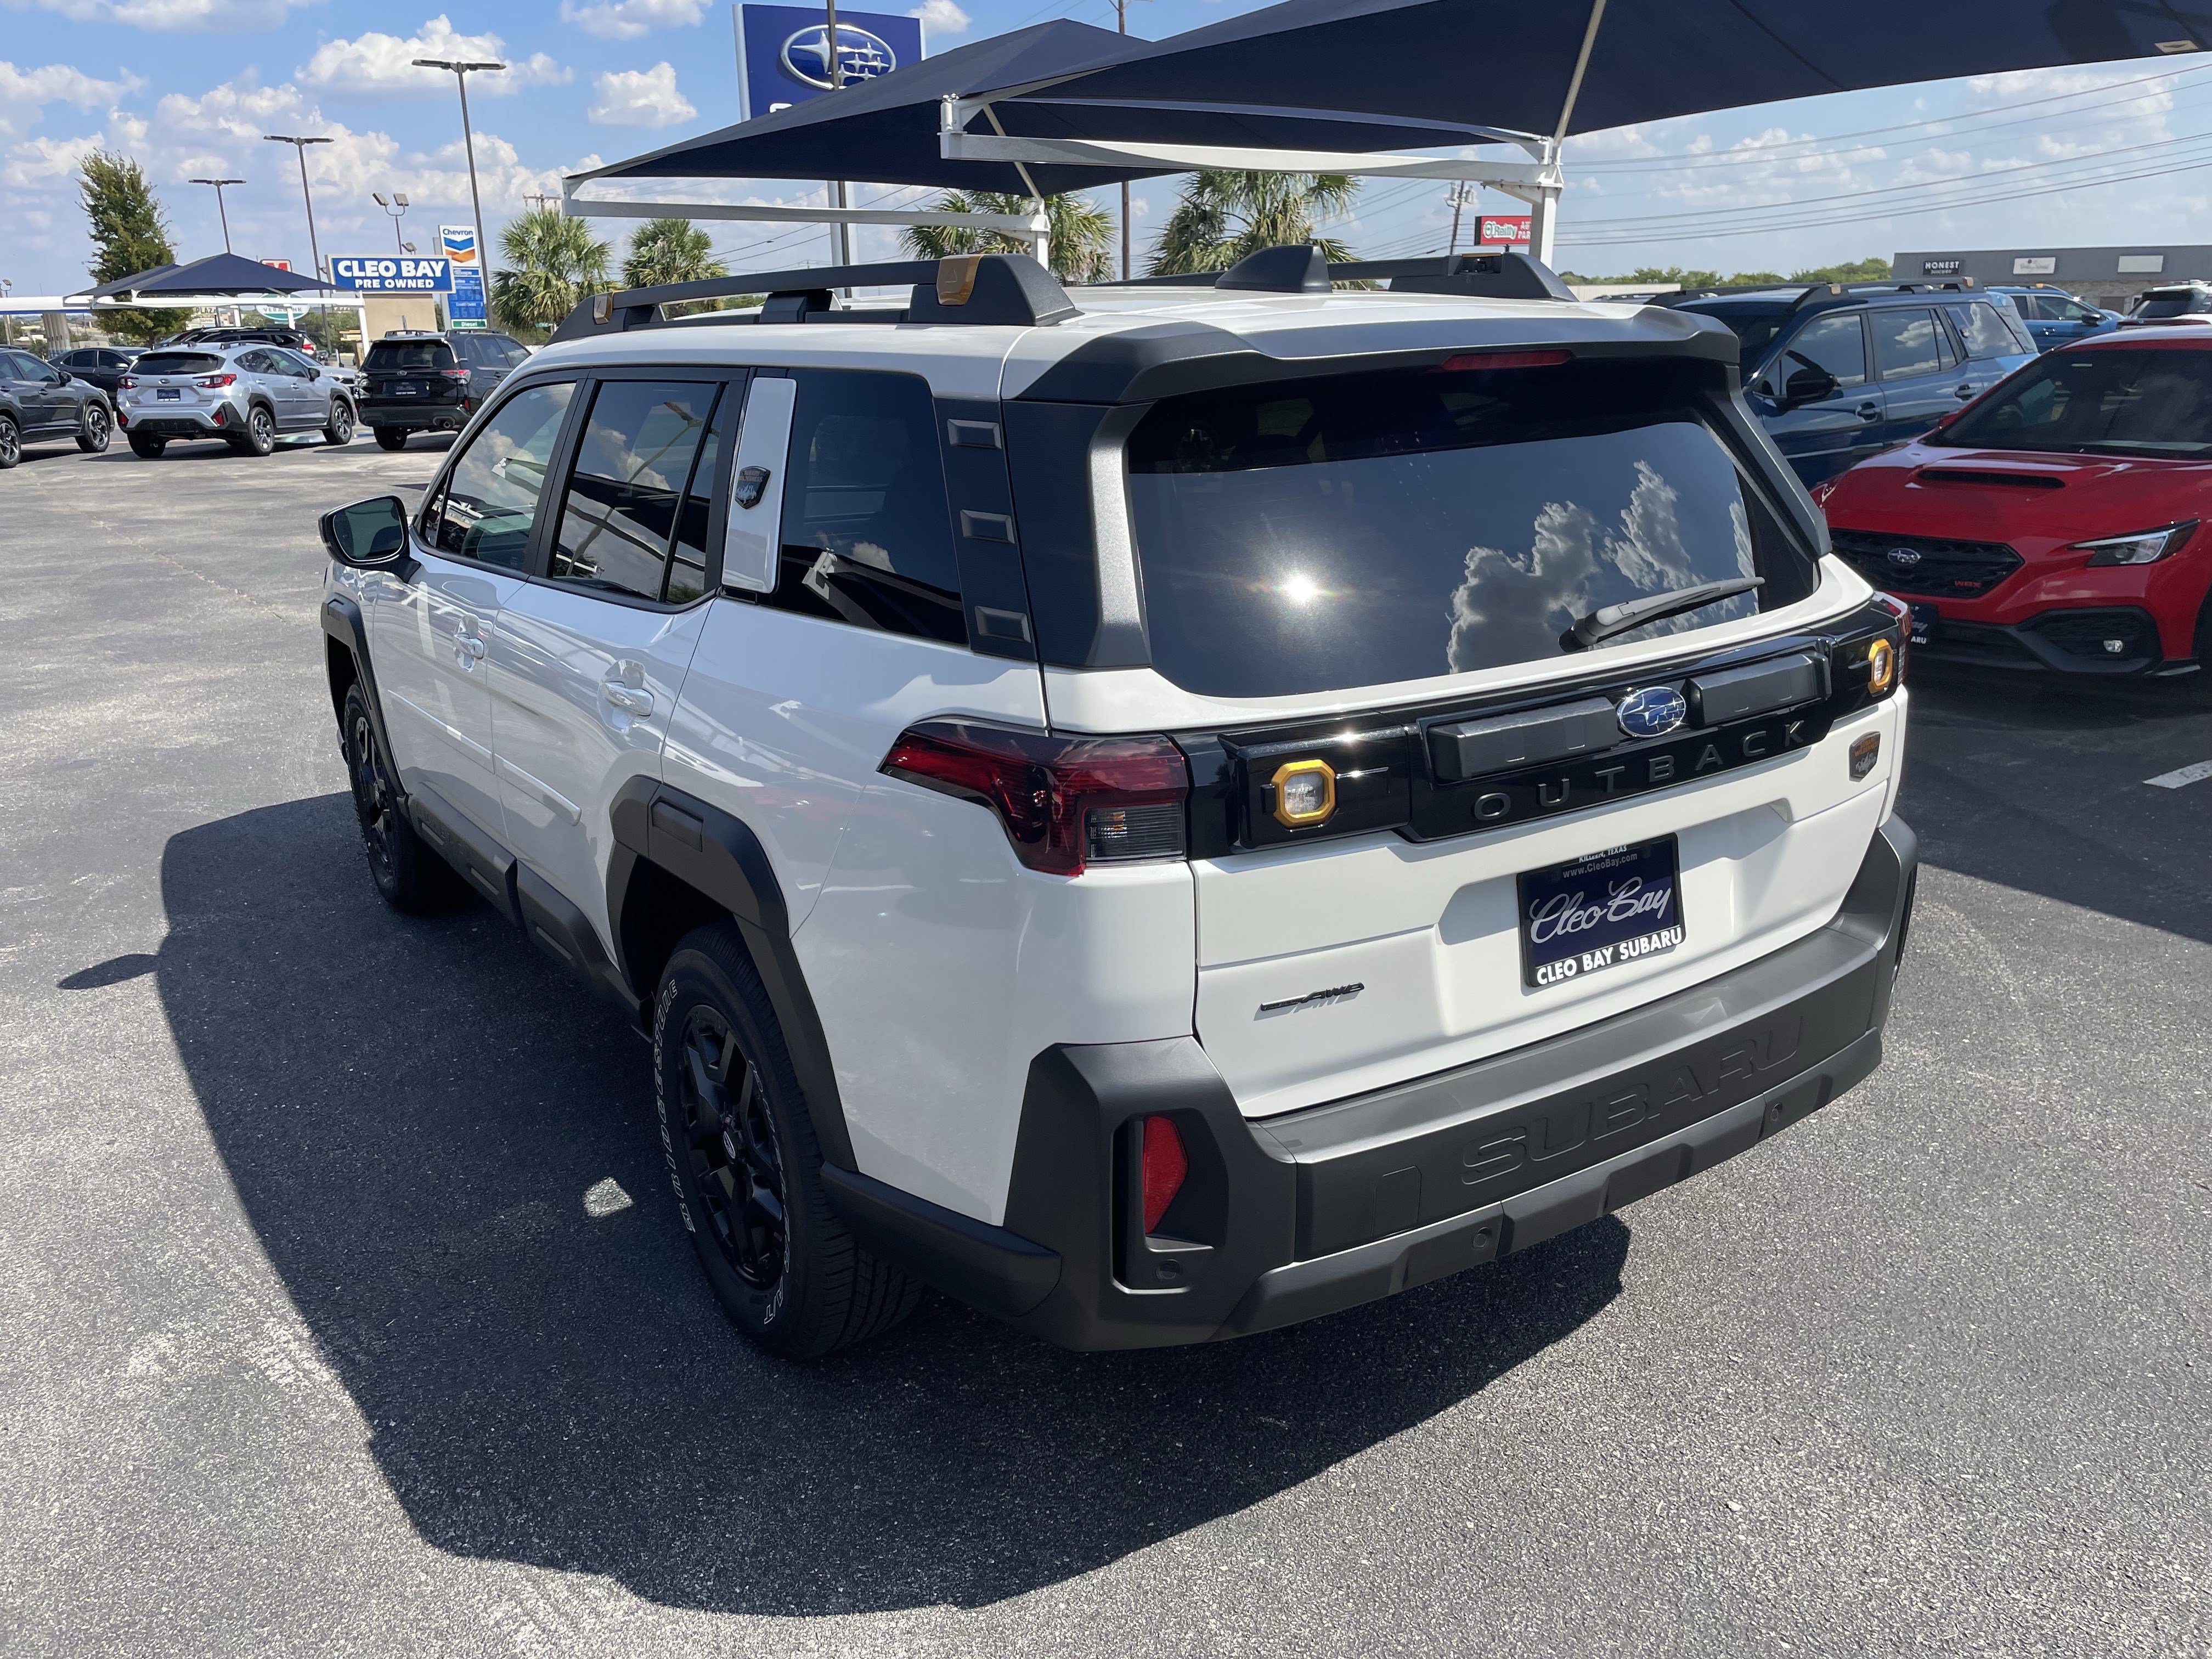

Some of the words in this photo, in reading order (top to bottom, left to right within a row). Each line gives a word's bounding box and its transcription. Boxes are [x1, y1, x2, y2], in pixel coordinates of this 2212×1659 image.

[1483, 221, 1517, 240] O'Reilly
[1520, 221, 1531, 230] AU
[1518, 231, 1531, 240] PAR
[337, 260, 397, 277] CLEO
[400, 261, 445, 277] BAY
[1925, 261, 1959, 269] HONEST
[355, 279, 380, 288] PRE
[385, 279, 434, 288] OWNED
[1911, 635, 1927, 645] ARU
[1474, 720, 1804, 821] OUTBACK
[1607, 845, 1628, 856] TEXAS
[1562, 853, 1638, 878] www.CleoBay.com
[1529, 891, 1607, 944] Cleo
[1606, 877, 1671, 922] Bay
[1536, 958, 1577, 985] CLEO
[1582, 946, 1615, 972] BAY
[1619, 926, 1683, 961] SUBARU
[1301, 981, 1365, 1003] AWD
[653, 979, 696, 1234] BRIDGESTONE
[1460, 1014, 1804, 1186] SUBARU
